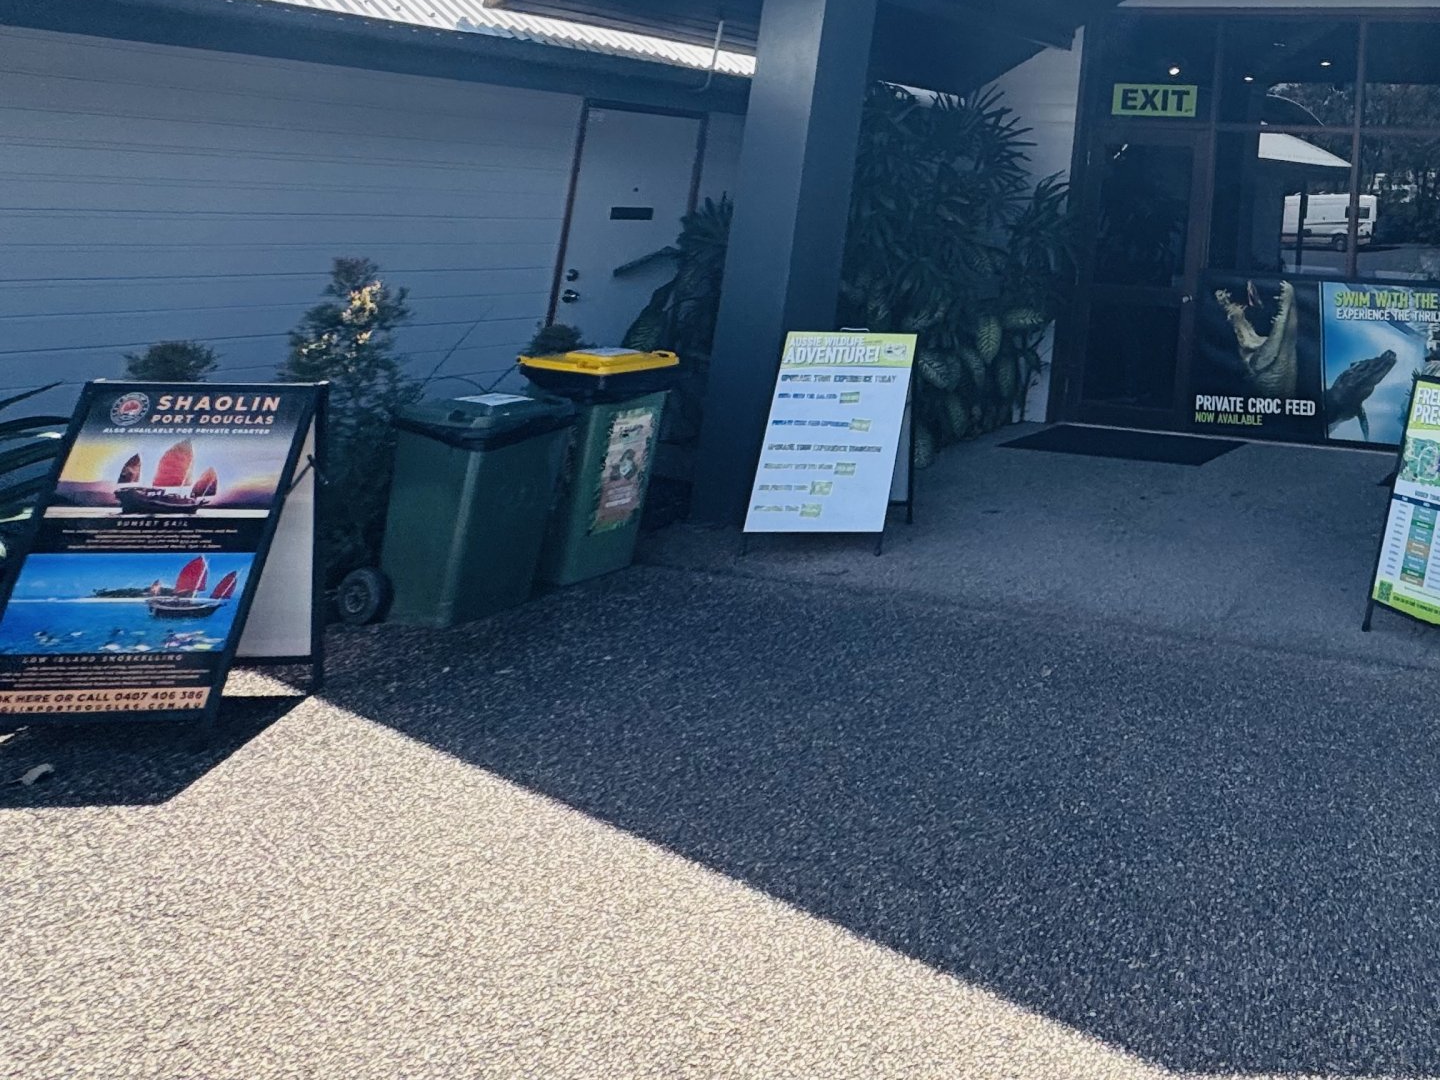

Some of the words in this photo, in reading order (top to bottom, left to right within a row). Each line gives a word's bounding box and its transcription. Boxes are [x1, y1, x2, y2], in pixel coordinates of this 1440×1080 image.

[1121, 88, 1190, 112] EXIT
[1334, 290, 1370, 307] SWIM
[1376, 290, 1409, 308] WITH
[1415, 292, 1438, 309] THE
[1336, 309, 1390, 321] EXPERIENCE
[1393, 309, 1410, 322] THE
[791, 336, 821, 347] AUSSIE
[825, 336, 866, 347] WILDLIFE
[783, 346, 880, 364] ADVENTURE!
[157, 395, 280, 411] SHAOLIN
[1195, 395, 1244, 413] PRIVATE
[1248, 397, 1281, 414] CROC
[1285, 399, 1316, 416] FEED
[150, 414, 195, 424] PORT
[200, 415, 274, 425] DOUGLAS
[1195, 412, 1214, 423] NOW
[1217, 413, 1263, 426] AVAILABLE
[15, 694, 50, 703] HERE
[54, 693, 74, 702] OR
[77, 693, 109, 702] CALL
[114, 691, 148, 701] 0407
[151, 691, 176, 700] 406
